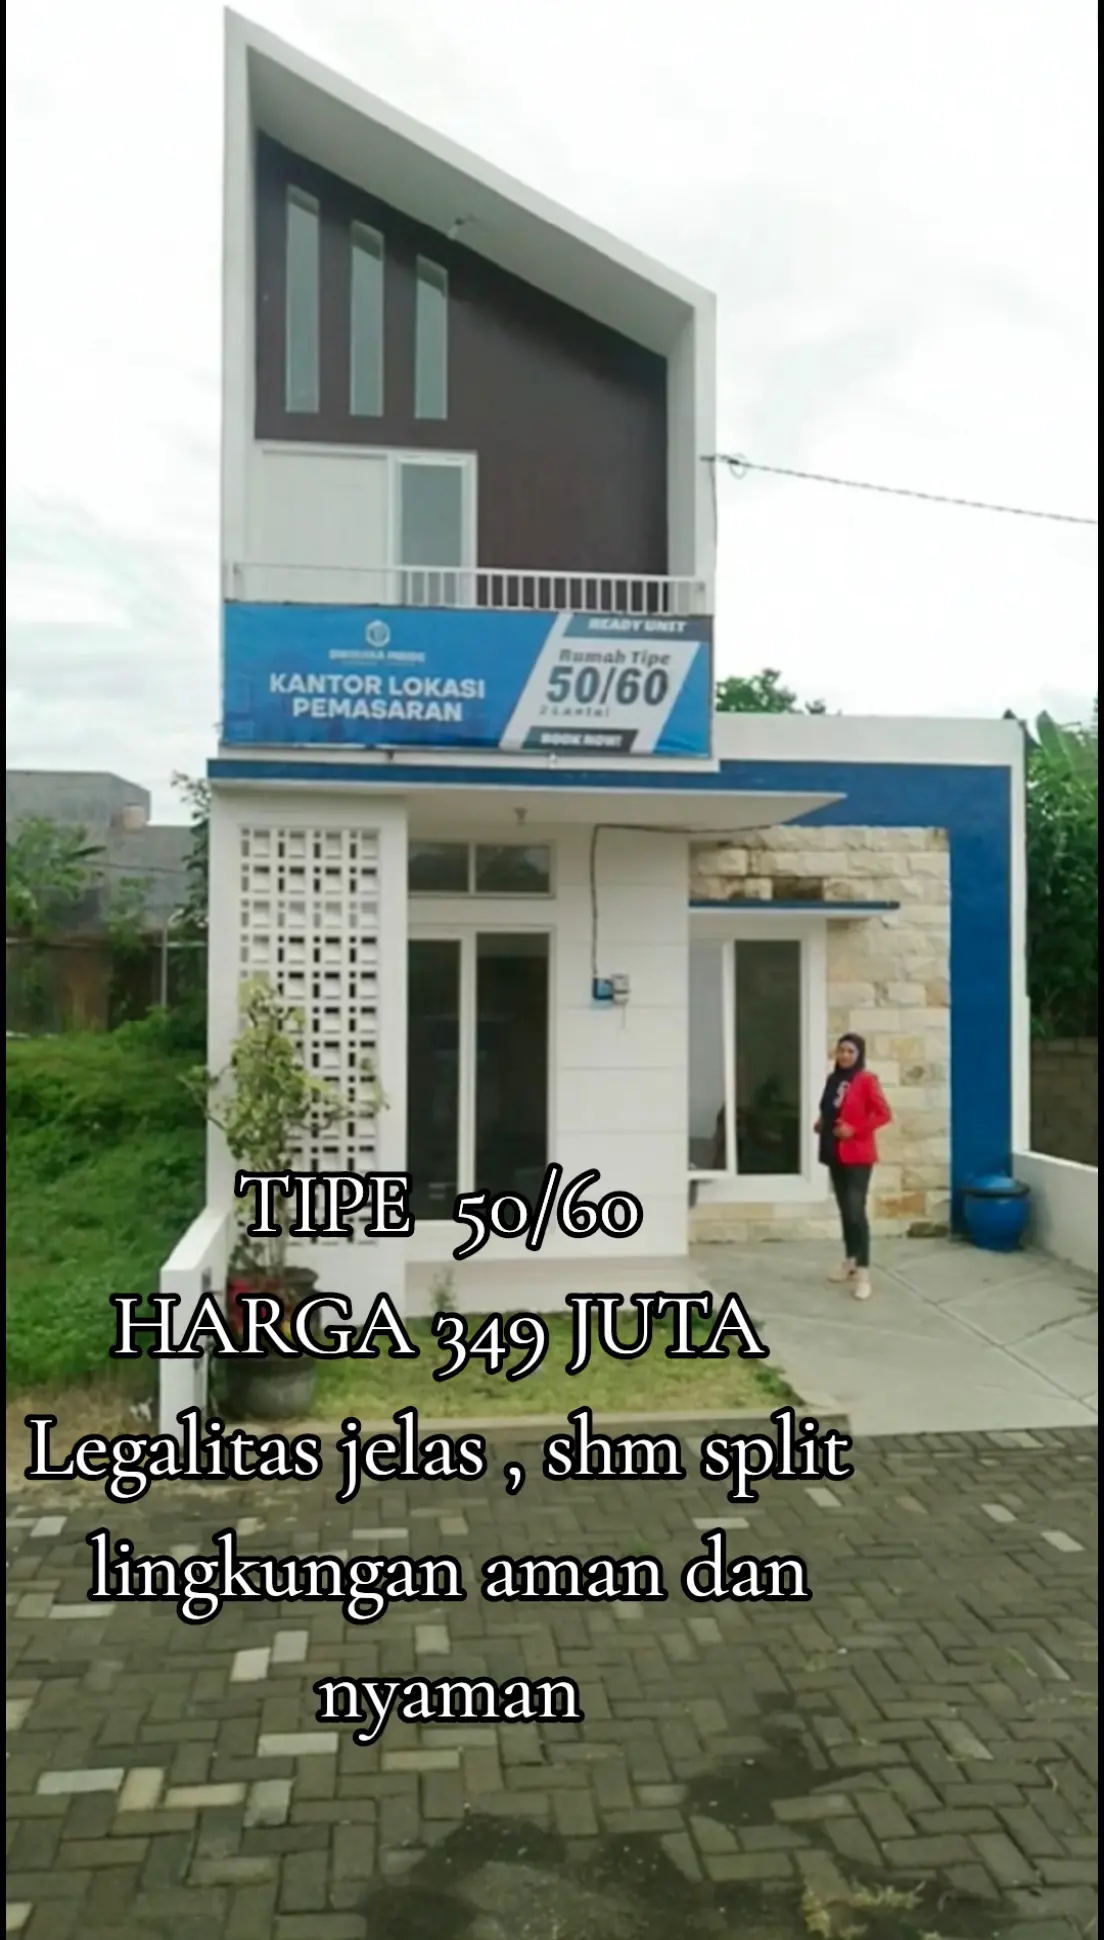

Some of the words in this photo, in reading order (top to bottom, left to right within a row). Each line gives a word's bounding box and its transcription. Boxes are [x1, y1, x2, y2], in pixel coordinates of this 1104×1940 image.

[644, 620, 687, 632] UNIT
[559, 649, 626, 664] Rumah
[630, 651, 671, 667] Tipe
[269, 672, 382, 694] KANTOR
[388, 675, 486, 699] LOKASI
[546, 666, 669, 706] 50/60
[291, 697, 463, 722] PEMASARAN
